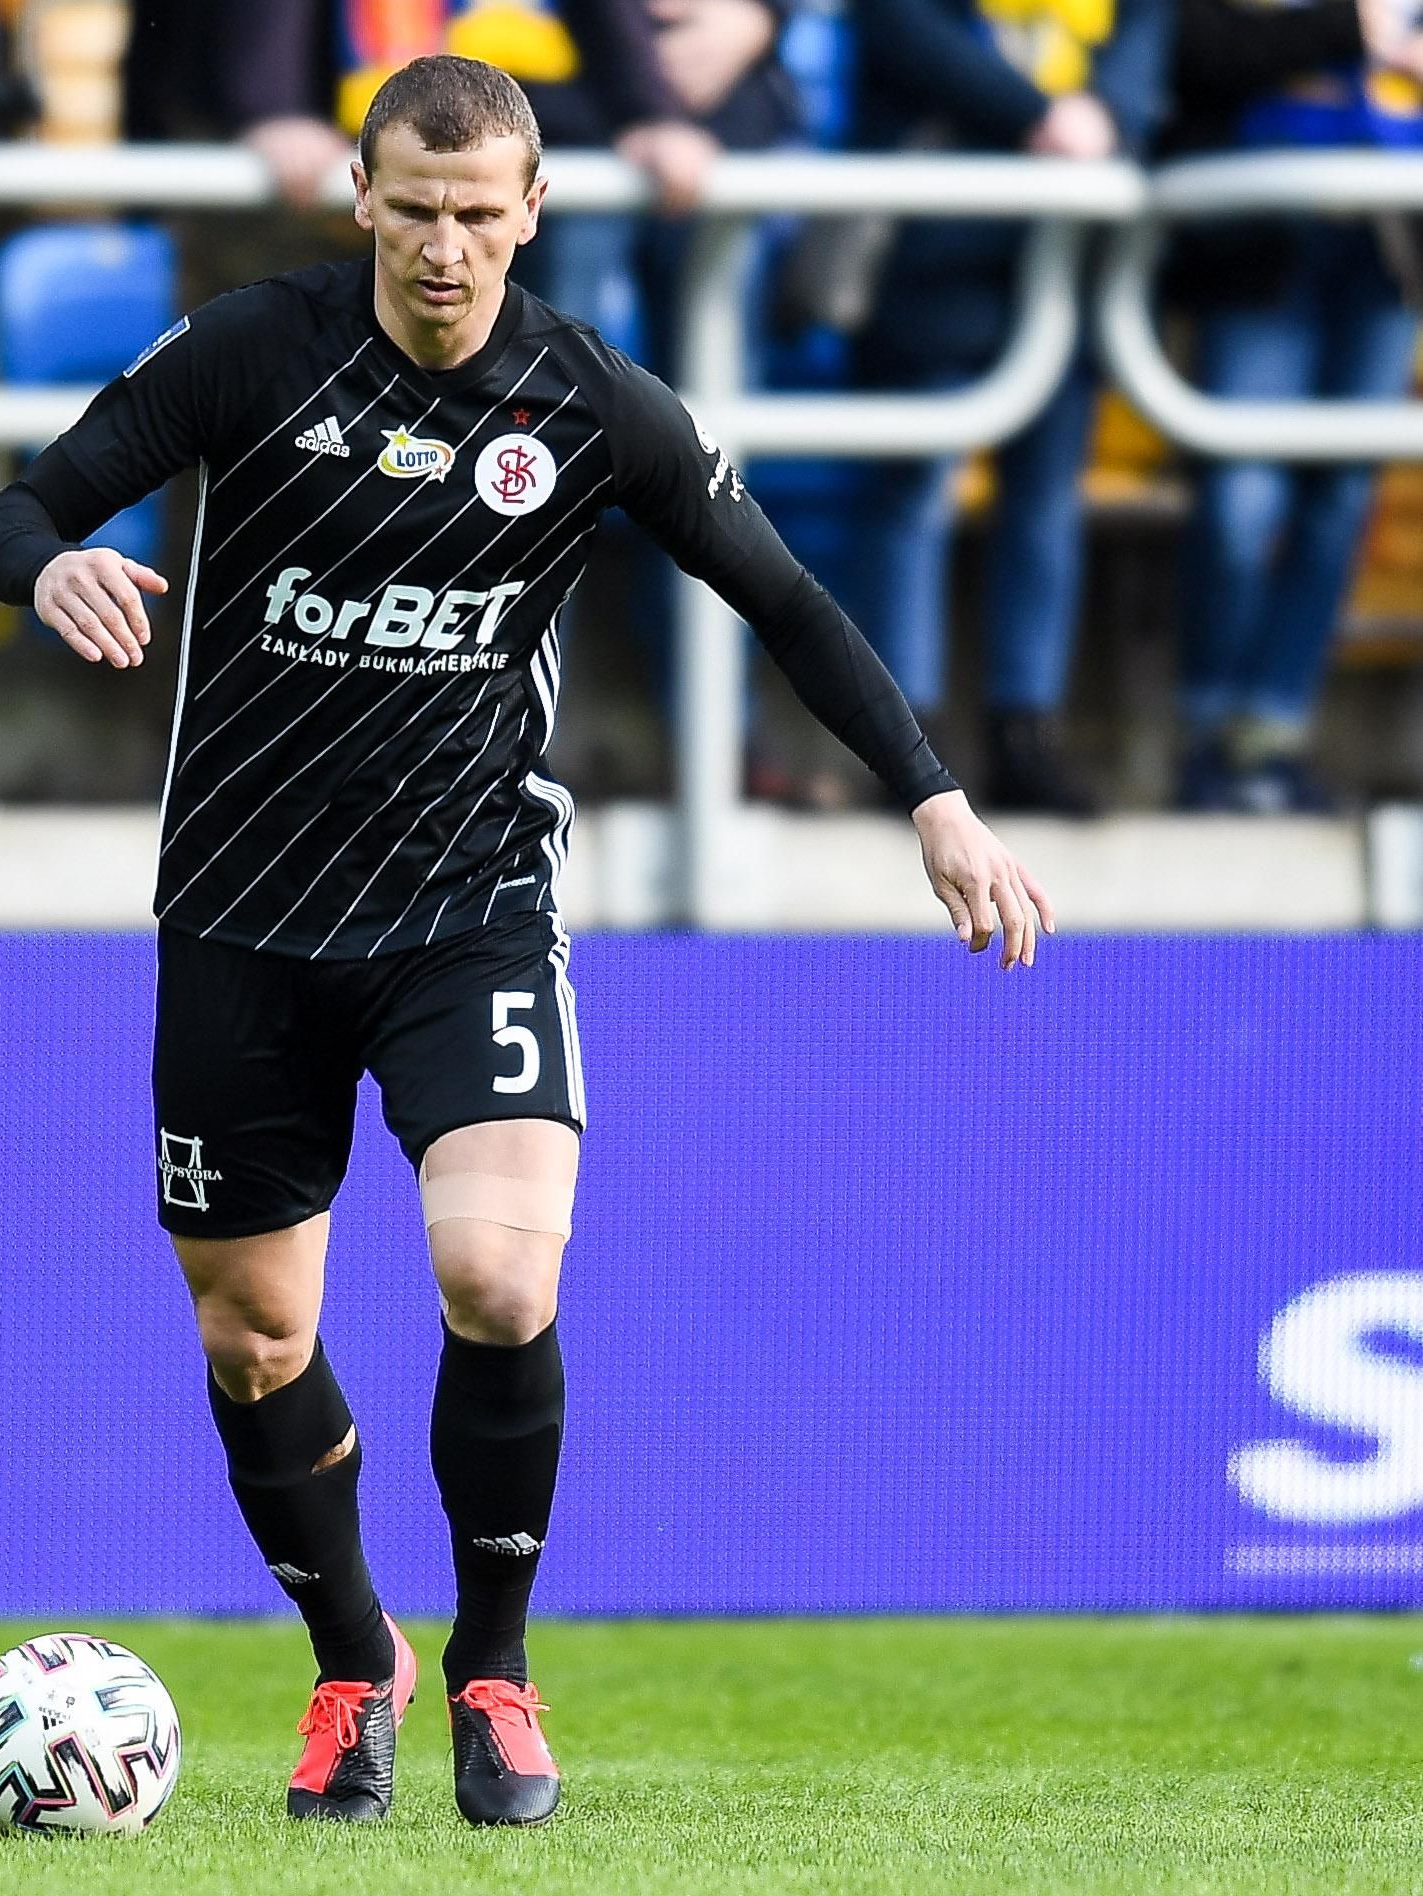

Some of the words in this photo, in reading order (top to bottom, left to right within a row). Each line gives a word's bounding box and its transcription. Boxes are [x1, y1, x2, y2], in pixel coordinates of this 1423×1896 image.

[295, 436, 351, 458] adidas
[396, 449, 438, 467] LOTTO
[264, 567, 525, 650] forBET
[260, 634, 351, 668] ZAKŁADY
[492, 991, 540, 1093] 5
